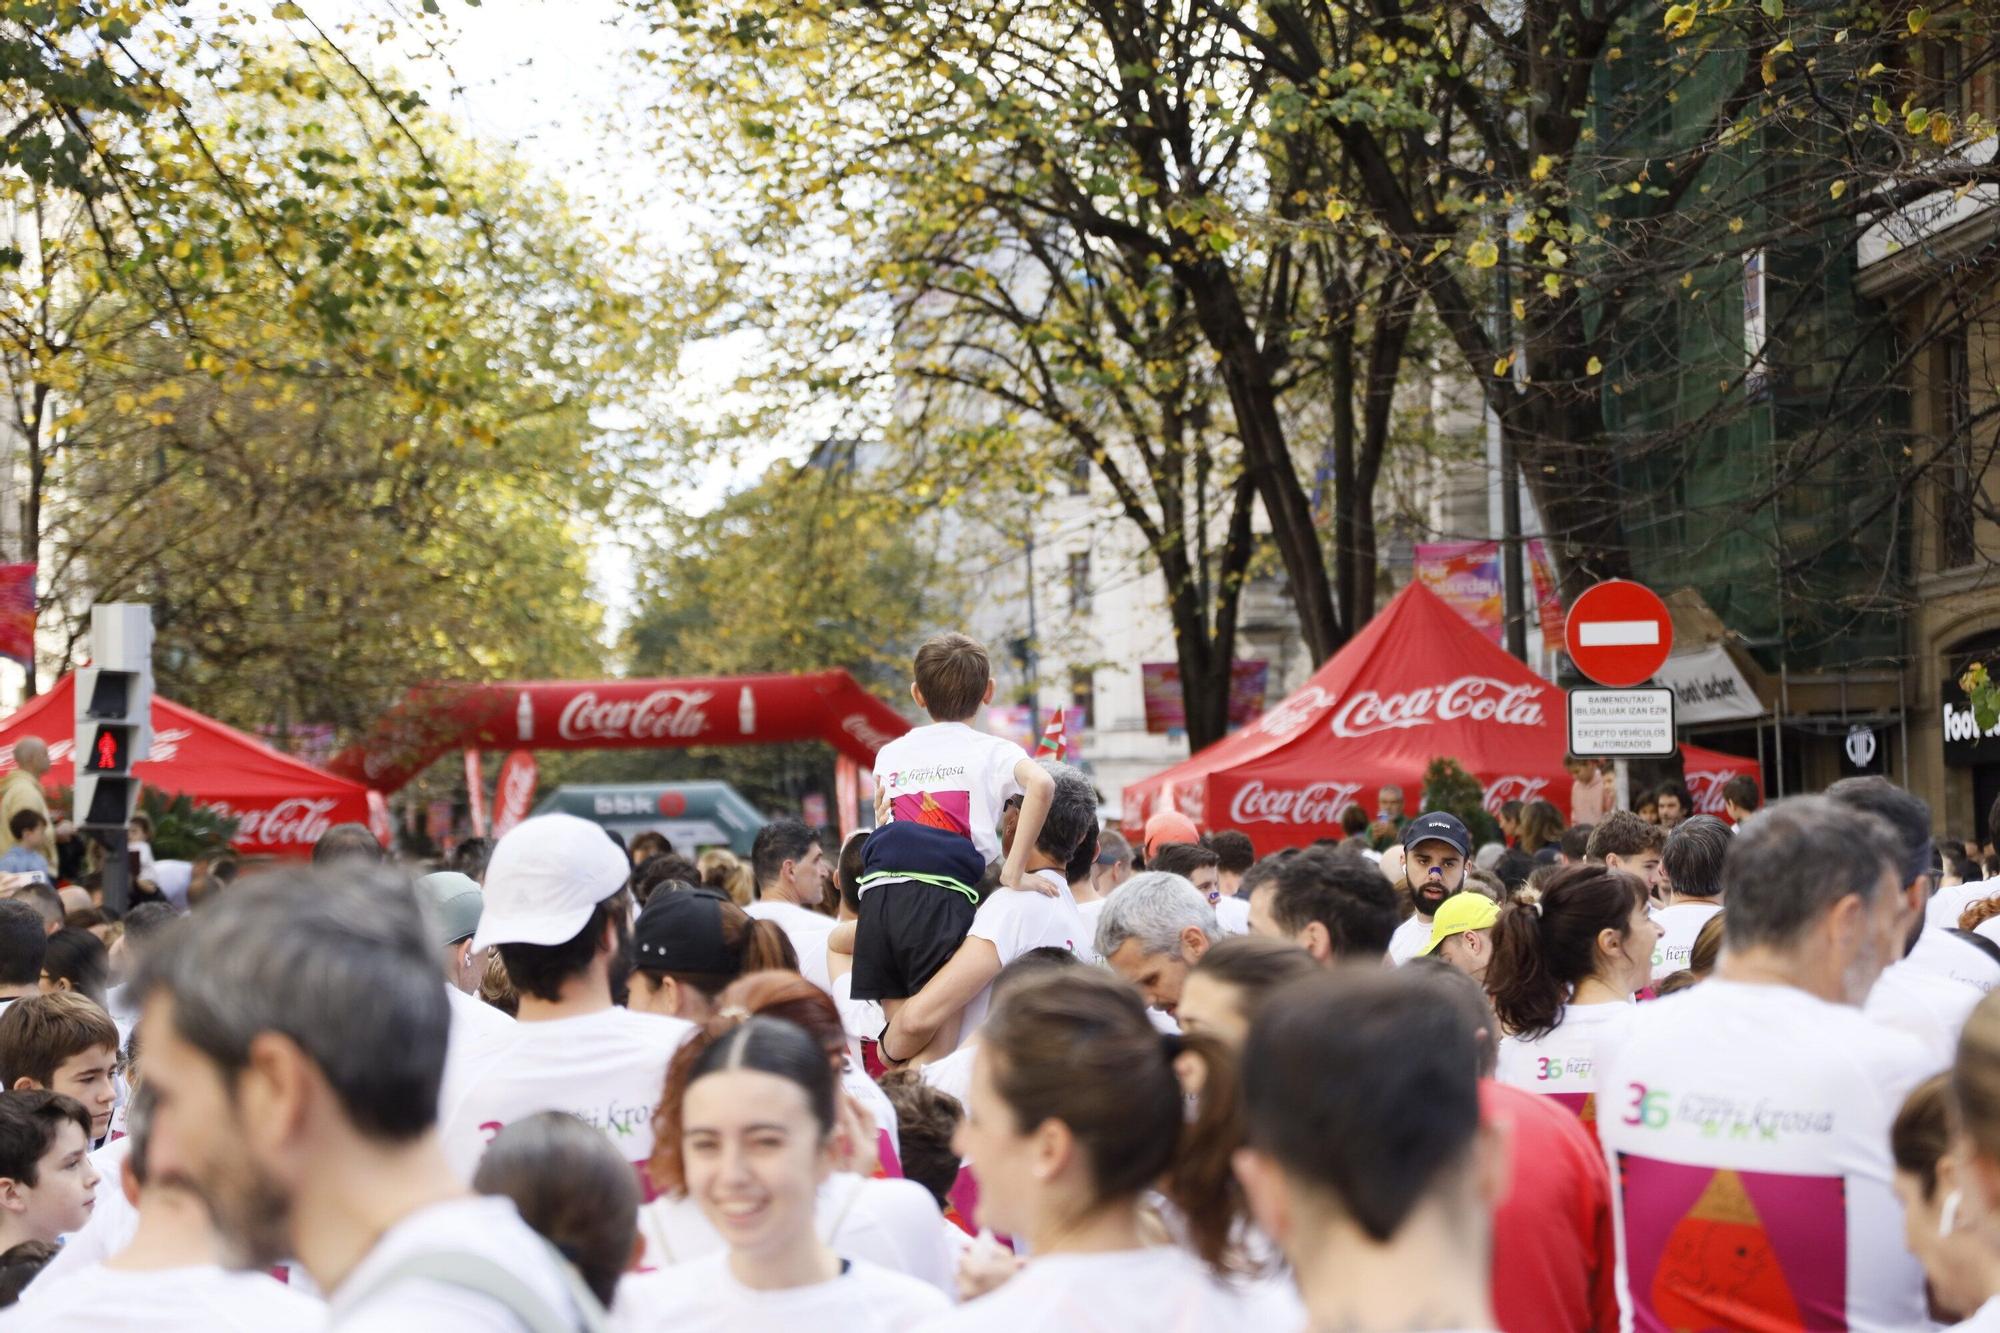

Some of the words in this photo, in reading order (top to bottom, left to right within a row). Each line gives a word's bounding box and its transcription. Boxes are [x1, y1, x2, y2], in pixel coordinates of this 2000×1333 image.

[559, 690, 714, 740] Coca-Cola
[1331, 676, 1546, 738] Coca-Cola
[1577, 729, 1617, 738] EXCEPTO
[1592, 740, 1652, 749] AUTORIZADOS
[934, 764, 965, 780] krosa
[1665, 946, 1693, 961] herr
[1537, 1057, 1563, 1080] 36
[1565, 1058, 1592, 1074] herr
[607, 1100, 650, 1131] kro
[1622, 1083, 1671, 1130] 36
